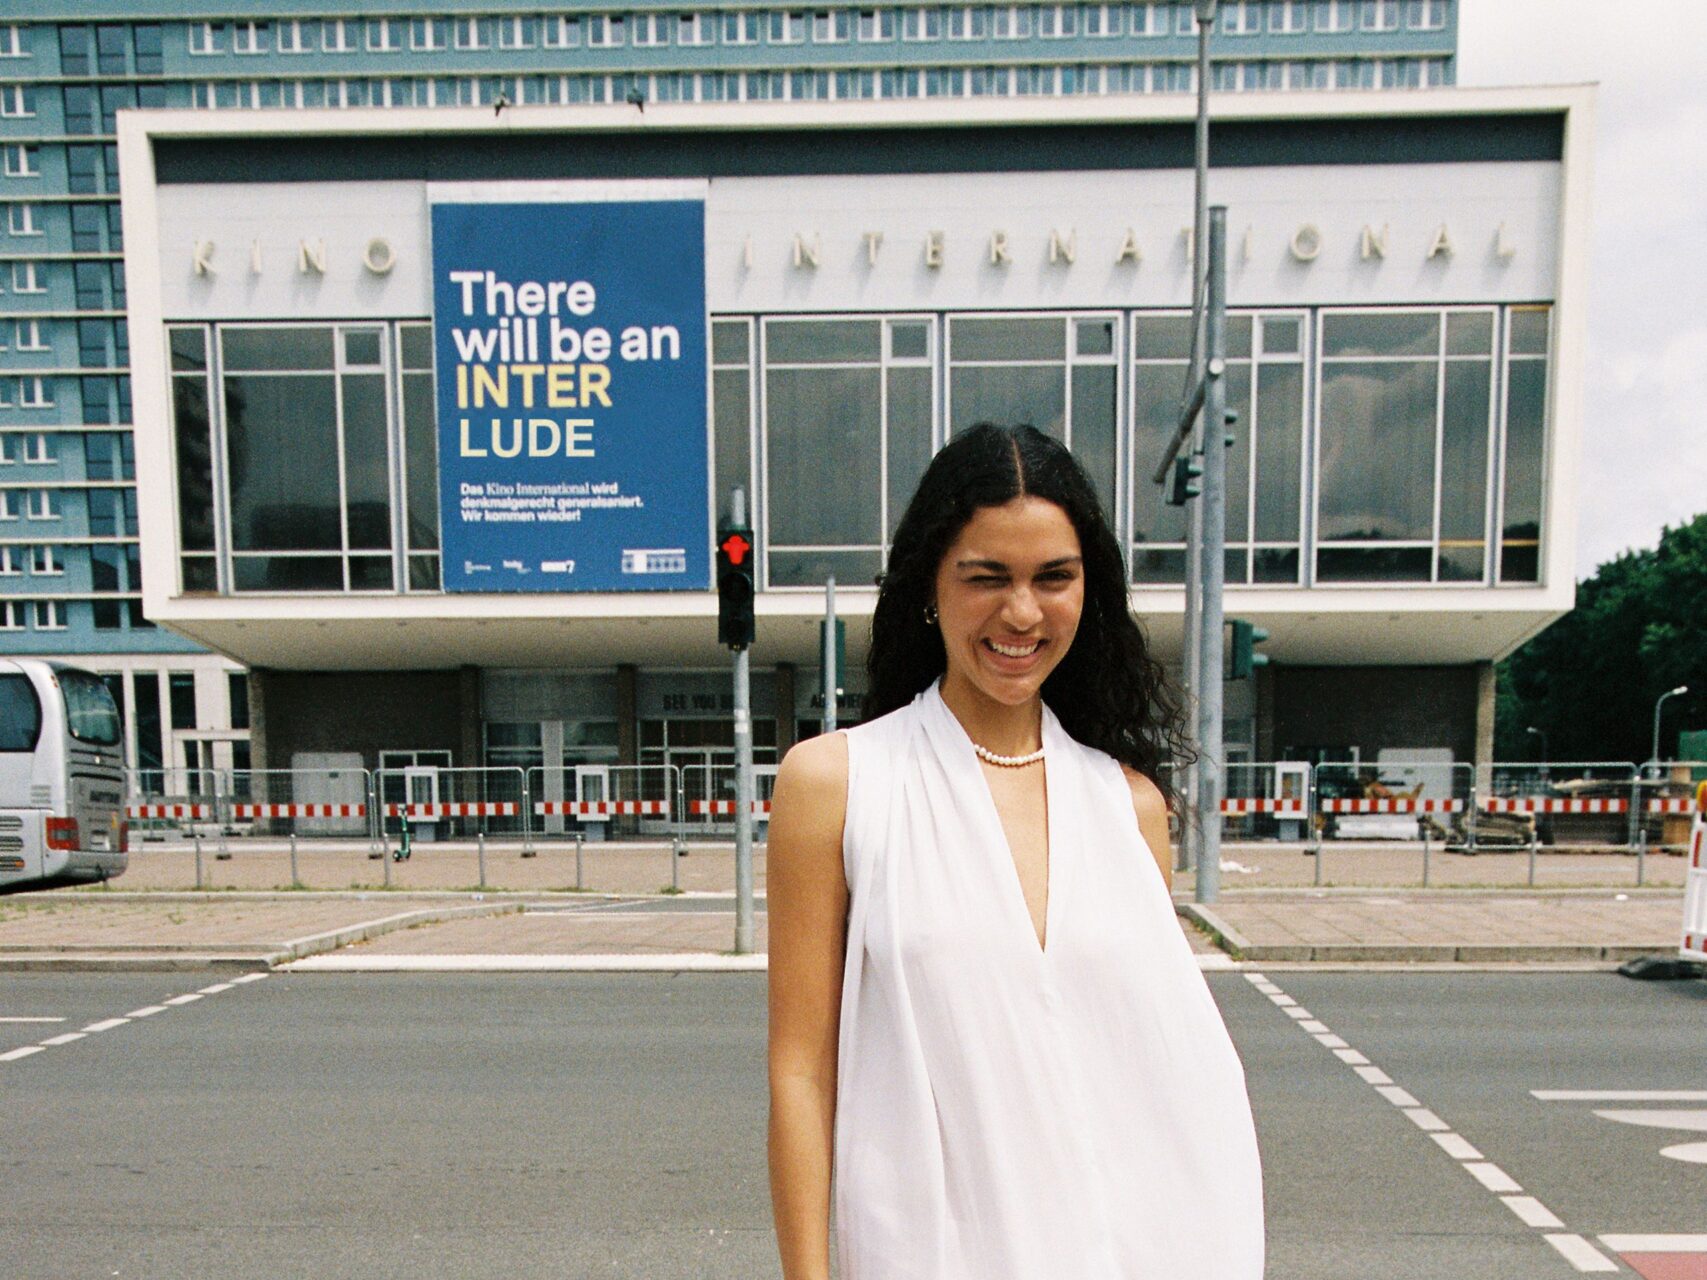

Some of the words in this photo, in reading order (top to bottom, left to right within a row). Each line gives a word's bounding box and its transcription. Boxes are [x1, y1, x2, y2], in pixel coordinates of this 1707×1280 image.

[193, 235, 397, 274] KINO
[744, 221, 1516, 270] INTERNATIONAL
[450, 271, 597, 317] There
[452, 317, 539, 363] will
[550, 317, 613, 363] be
[620, 325, 681, 362] an
[457, 363, 613, 410] INTER
[460, 418, 596, 459] LUDE
[460, 482, 484, 496] Das
[486, 482, 515, 496] Kino
[516, 482, 590, 496] International
[591, 482, 619, 495] wird
[460, 496, 556, 511] denkmalgerecht
[461, 509, 483, 522] Wir
[484, 509, 536, 522] kommen
[537, 508, 582, 522] wieder!
